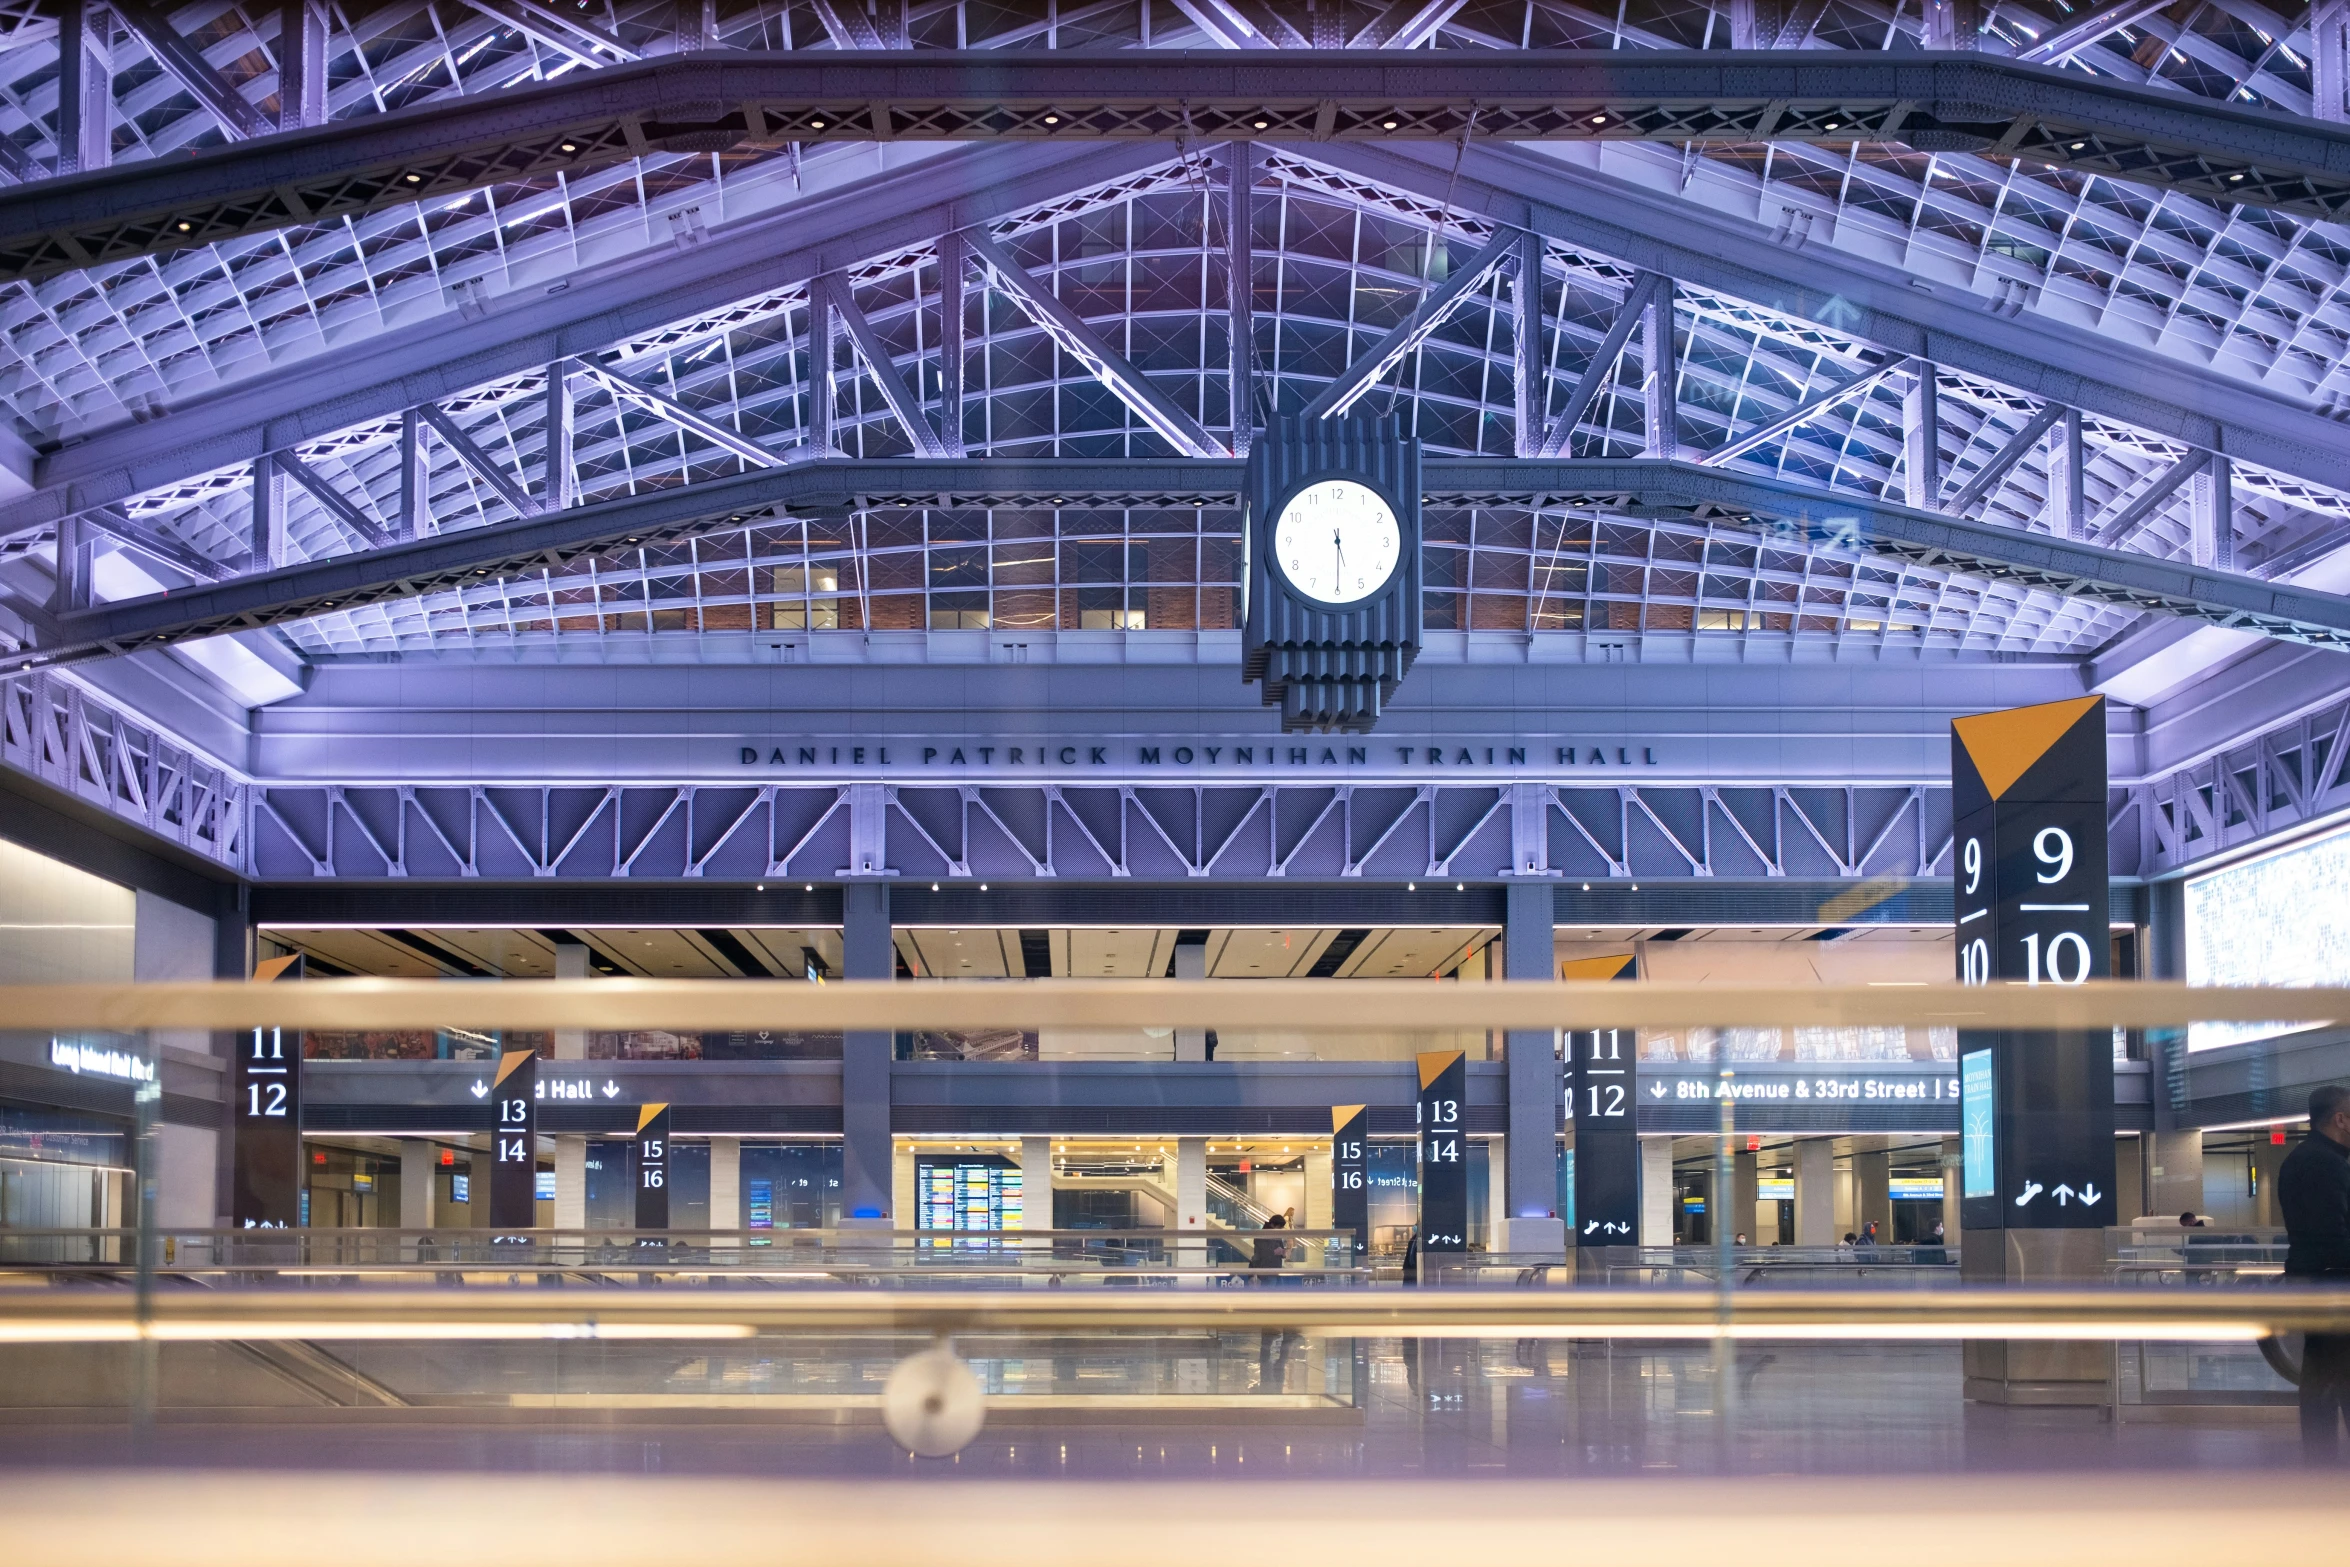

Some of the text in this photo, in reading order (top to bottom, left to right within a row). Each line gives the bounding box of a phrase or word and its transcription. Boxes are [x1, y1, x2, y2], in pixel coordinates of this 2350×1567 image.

[1308, 494, 1318, 505] 11
[1332, 488, 1344, 500] 12
[1360, 495, 1365, 506] 1
[1290, 512, 1302, 524] 10
[1376, 512, 1383, 524] 2
[1285, 536, 1293, 548] 9
[1382, 537, 1390, 548] 3
[1292, 560, 1299, 571] 8
[1375, 560, 1383, 571] 4
[1309, 578, 1317, 589] 7
[1334, 585, 1341, 596] 6
[1357, 578, 1365, 590] 5
[741, 747, 1658, 766] DANIEL PATRICK MOYNIHAN TRAIN HALL
[2032, 827, 2073, 884] 9
[1963, 837, 1981, 894] 9
[1960, 938, 1989, 986] 10
[2019, 932, 2091, 986] 10
[252, 1026, 283, 1058] 11
[1589, 1028, 1622, 1060] 11
[550, 1079, 593, 1099] Hall
[1676, 1081, 1710, 1098] 8th
[1715, 1080, 1789, 1098] Avenue
[1795, 1080, 1810, 1098] &
[1815, 1080, 1859, 1098] 33rd
[1865, 1080, 1926, 1098] Street
[248, 1083, 287, 1116] 12
[1586, 1085, 1625, 1117] 12
[500, 1099, 526, 1122] 13
[1432, 1100, 1458, 1123] 13
[71, 1133, 89, 1146] Service
[498, 1139, 527, 1162] 14
[642, 1140, 663, 1158] 15
[1341, 1142, 1361, 1159] 15
[1431, 1139, 1459, 1162] 14
[642, 1170, 663, 1188] 16
[1341, 1171, 1362, 1189] 16
